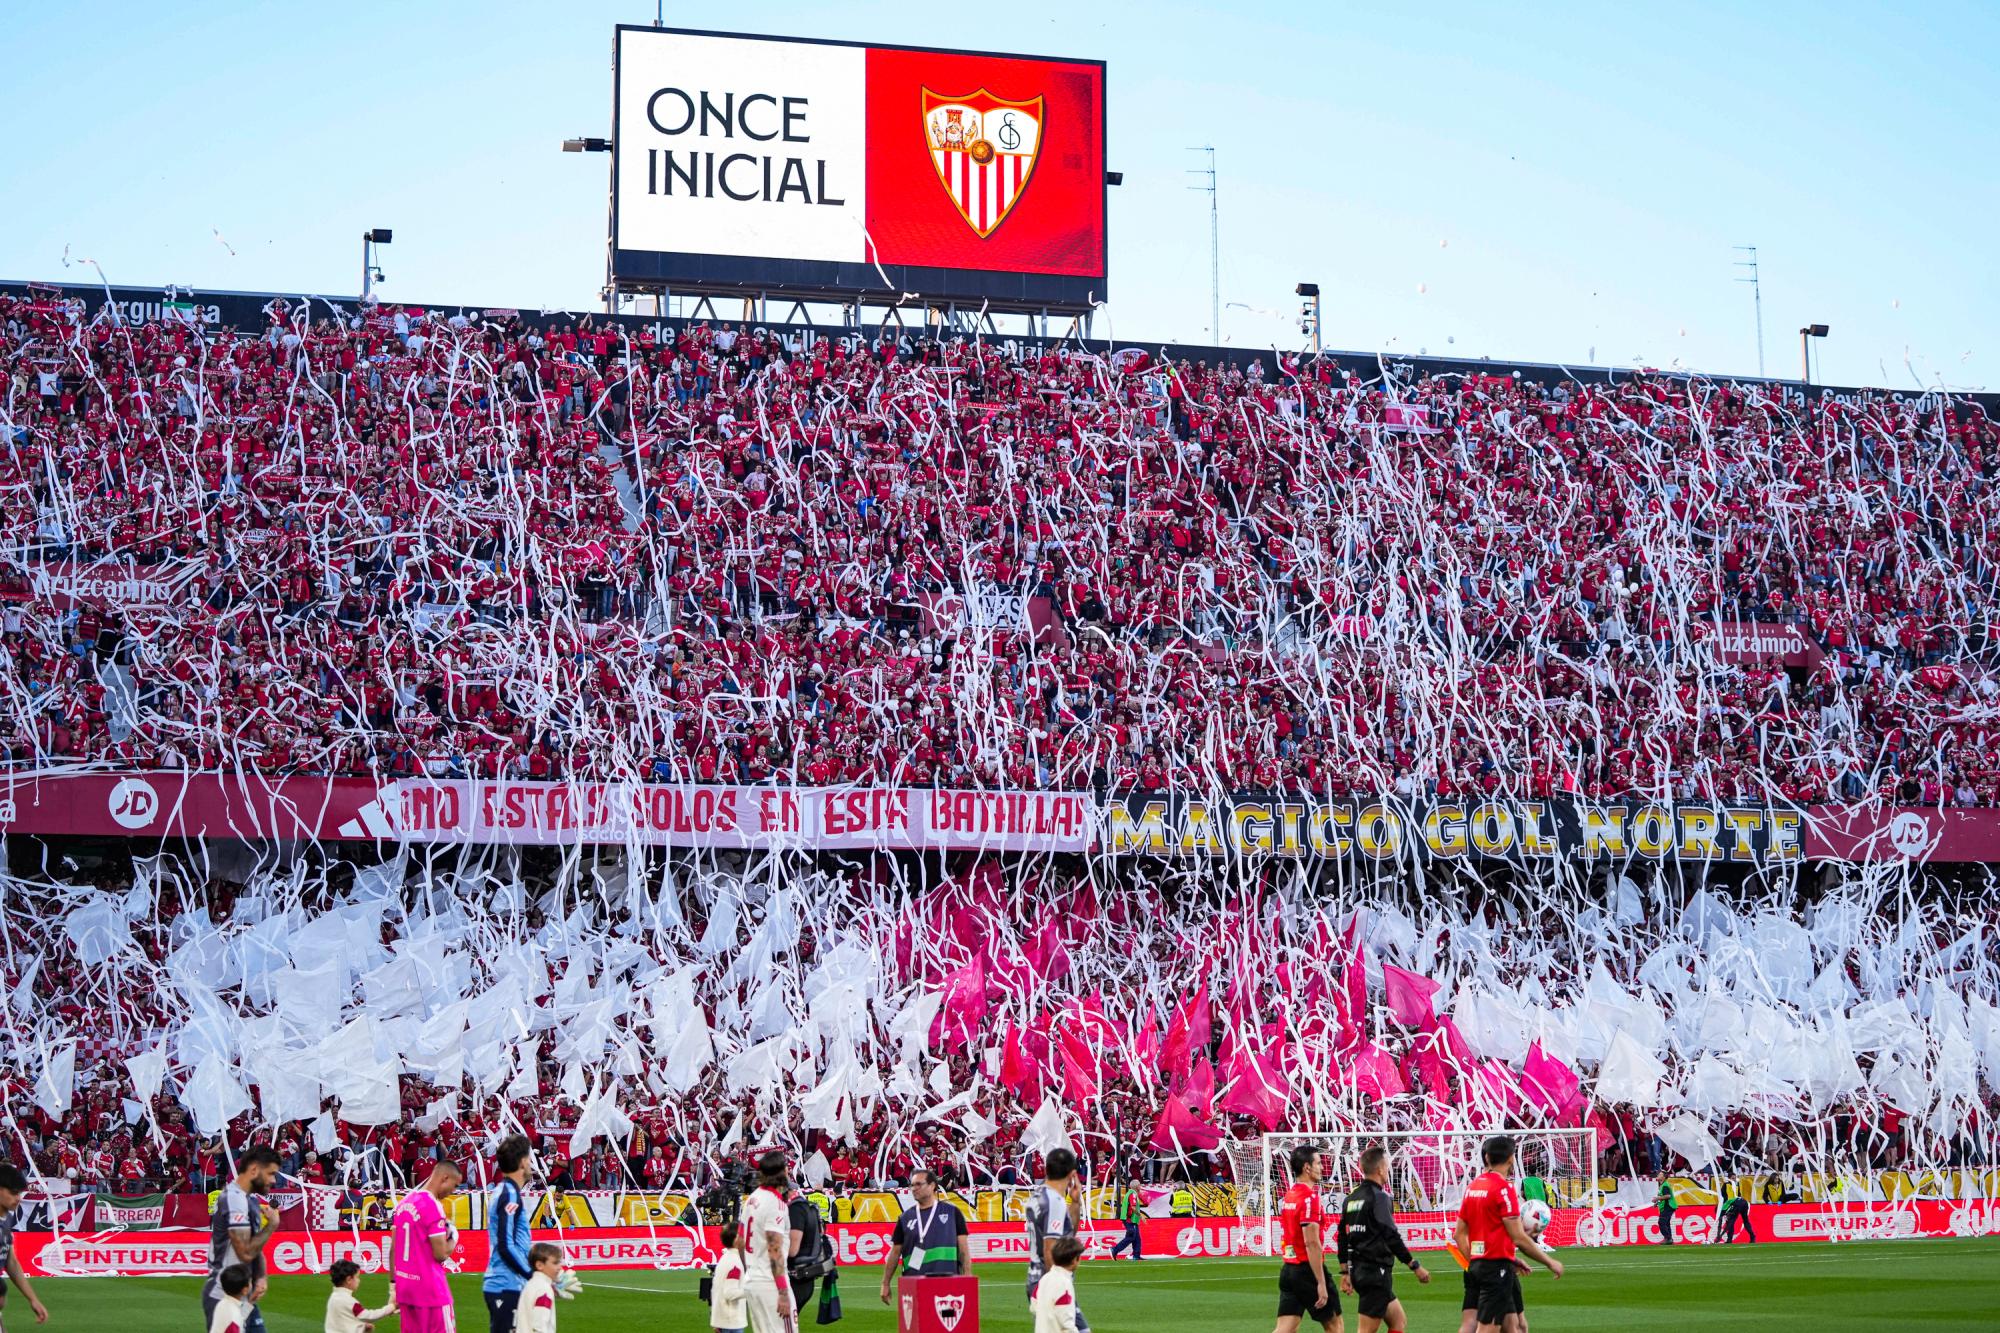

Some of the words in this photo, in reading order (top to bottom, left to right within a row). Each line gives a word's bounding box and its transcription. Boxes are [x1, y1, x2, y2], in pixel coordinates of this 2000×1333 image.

[646, 86, 810, 143] ONCE
[648, 148, 846, 206] INICIAL
[648, 321, 675, 345] de
[115, 790, 153, 816] JD
[630, 786, 737, 834] SOLOS
[758, 790, 800, 833] EN
[824, 789, 909, 835] ESTA
[1104, 800, 1403, 859] MAGICO
[1427, 802, 1554, 860] GOL
[1577, 804, 1800, 862] NORTE
[64, 1248, 208, 1265] PINTURAS
[402, 1222, 410, 1262] 1
[562, 1243, 673, 1259] NTURAS
[1176, 1220, 1339, 1257] eurotx
